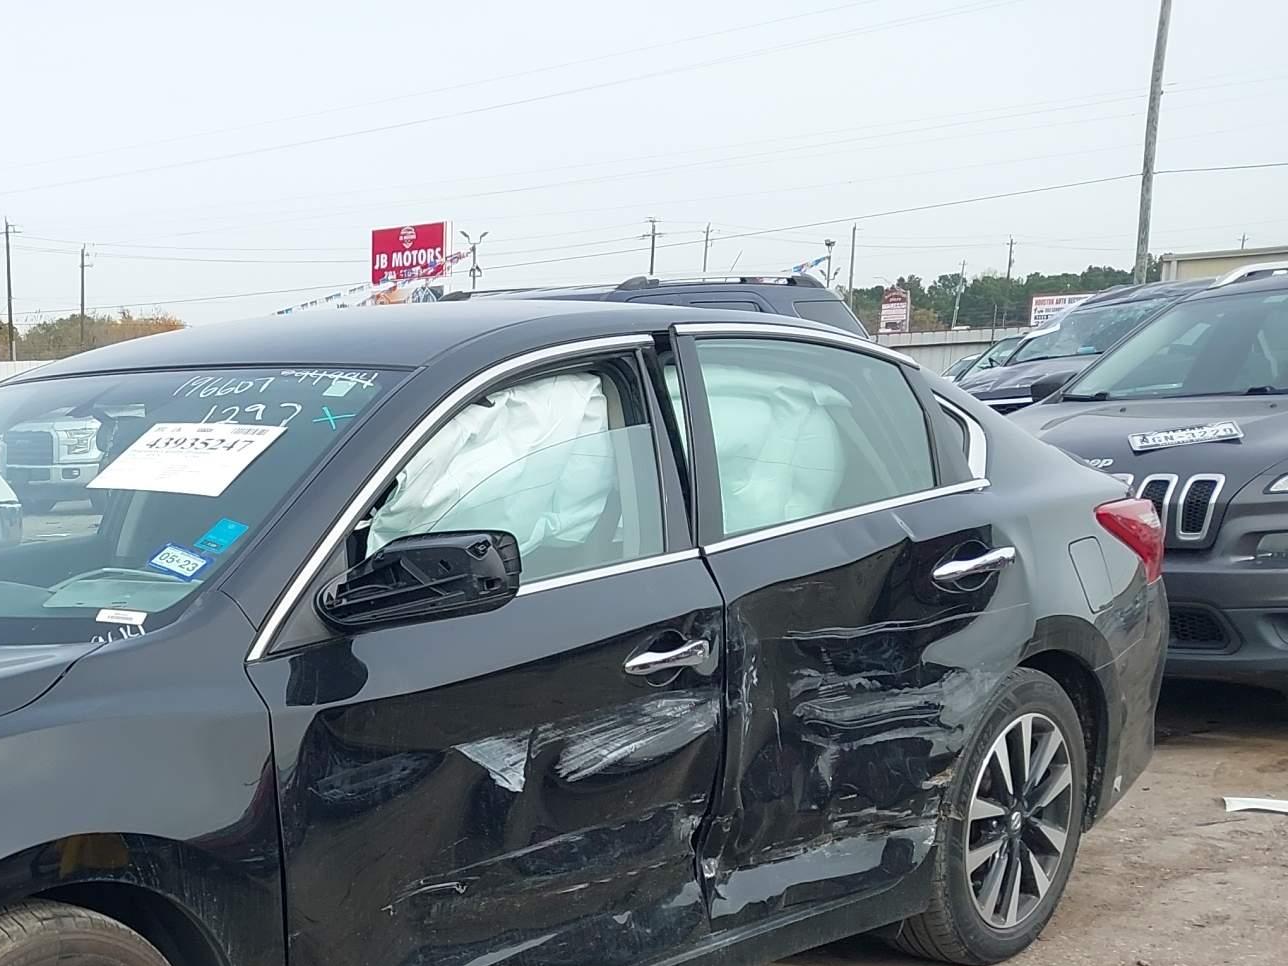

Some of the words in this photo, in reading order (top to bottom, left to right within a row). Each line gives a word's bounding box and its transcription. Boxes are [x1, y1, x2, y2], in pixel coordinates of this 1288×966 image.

[374, 253, 388, 270] JB
[392, 247, 442, 268] MOTORS
[145, 437, 255, 452] 43935247
